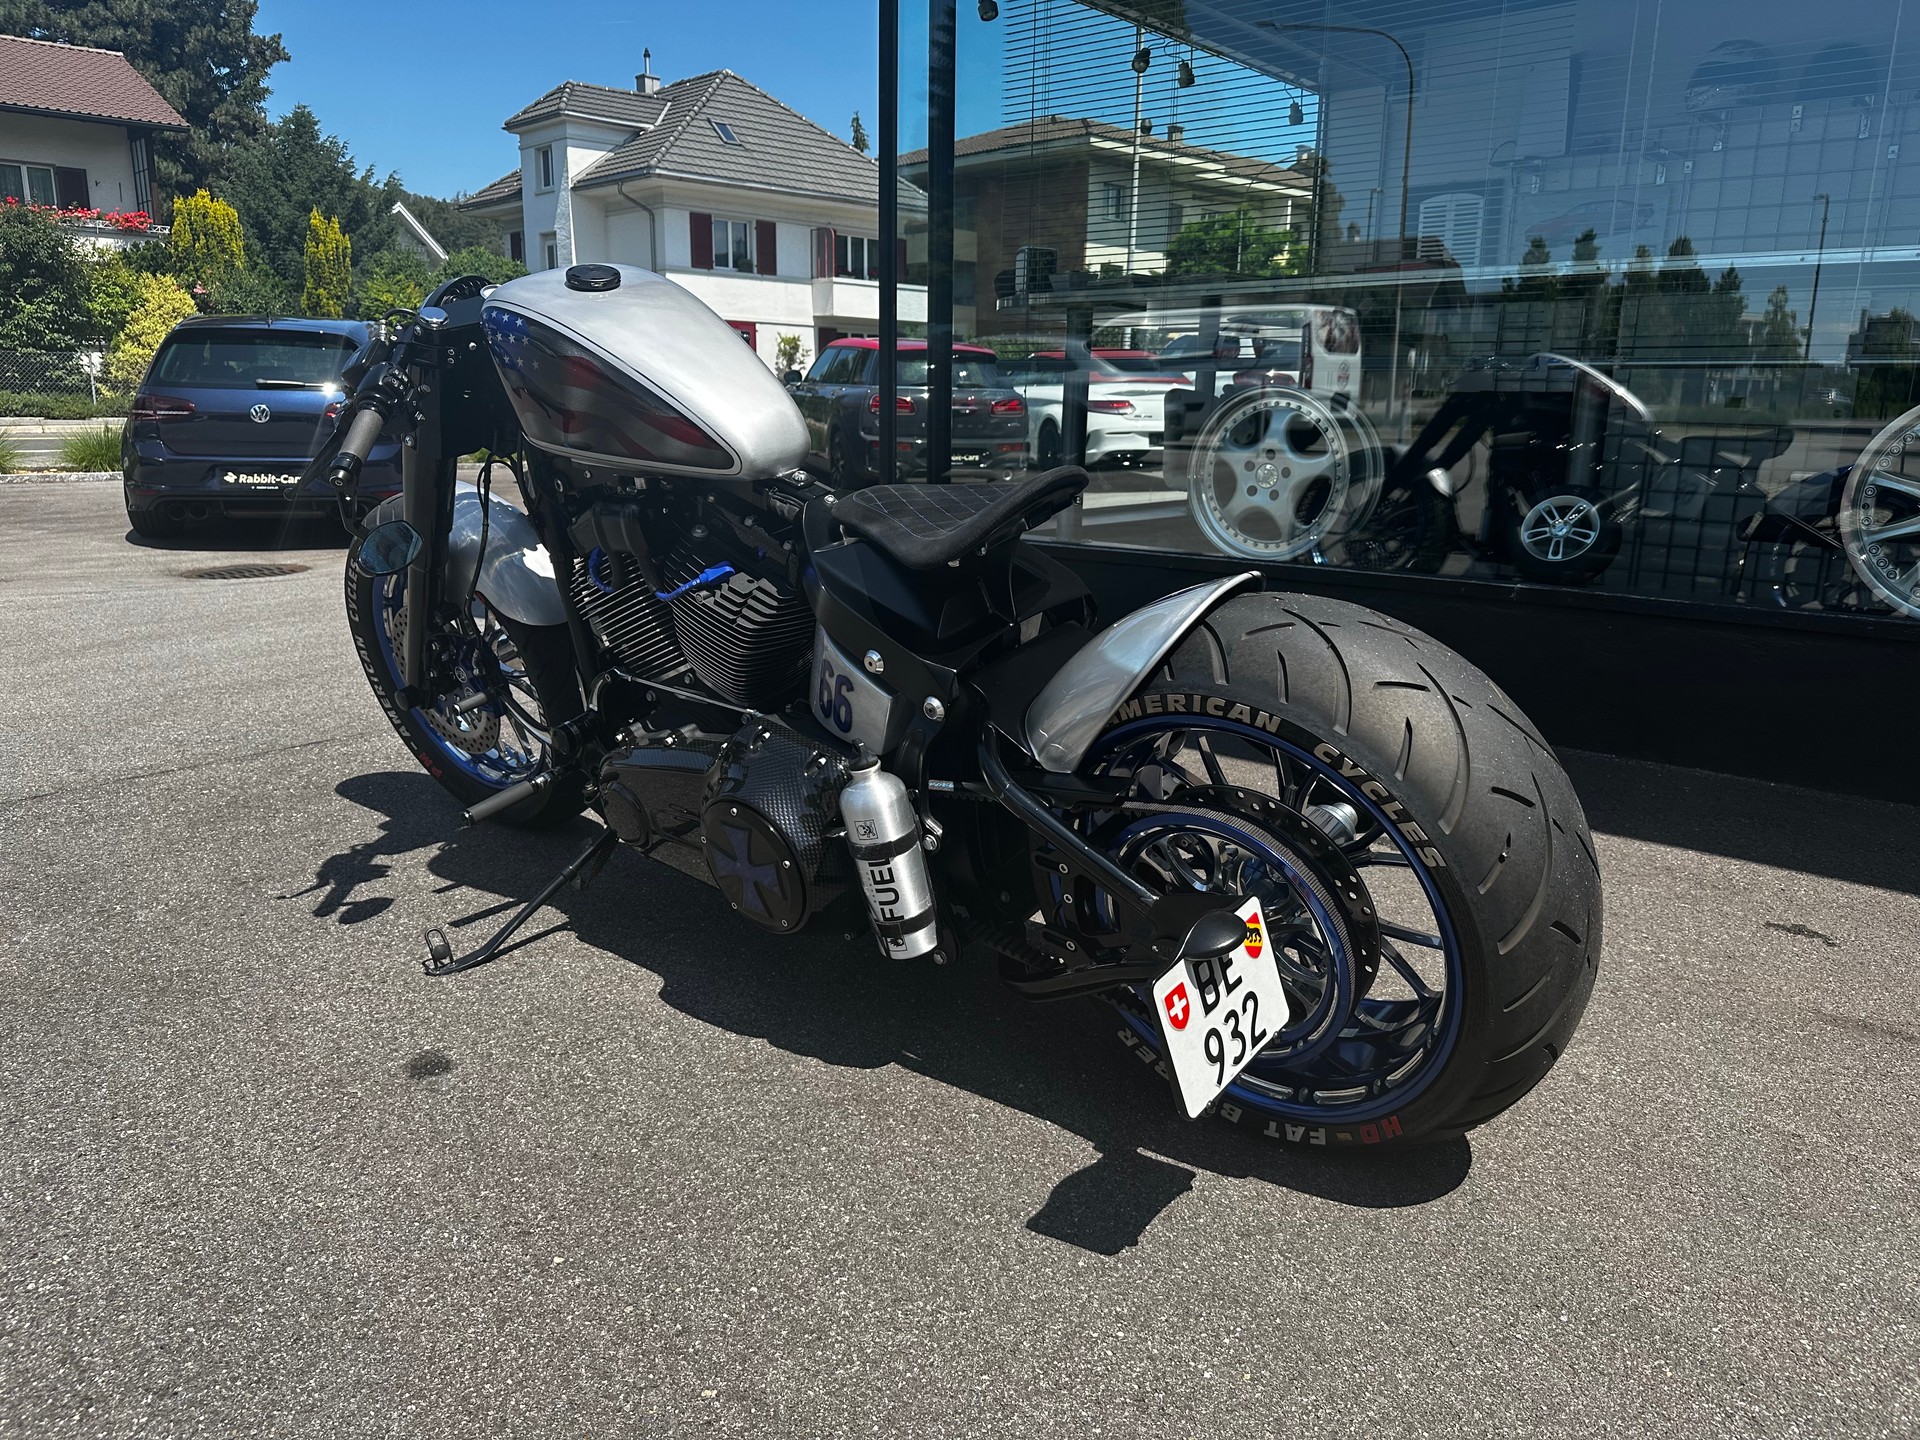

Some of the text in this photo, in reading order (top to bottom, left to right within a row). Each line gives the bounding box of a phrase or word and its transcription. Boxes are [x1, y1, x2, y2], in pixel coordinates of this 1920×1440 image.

[238, 473, 302, 484] Rabbit-Car
[347, 558, 361, 623] CYCLES
[354, 635, 410, 738] AMERICAN
[818, 658, 855, 734] 66
[1312, 742, 1447, 869] CYCLES
[867, 856, 905, 922] FUEL
[1193, 956, 1244, 1016] BE
[1203, 990, 1268, 1087] 932
[1263, 1121, 1328, 1146] FAT
[1359, 1115, 1403, 1145] HD
